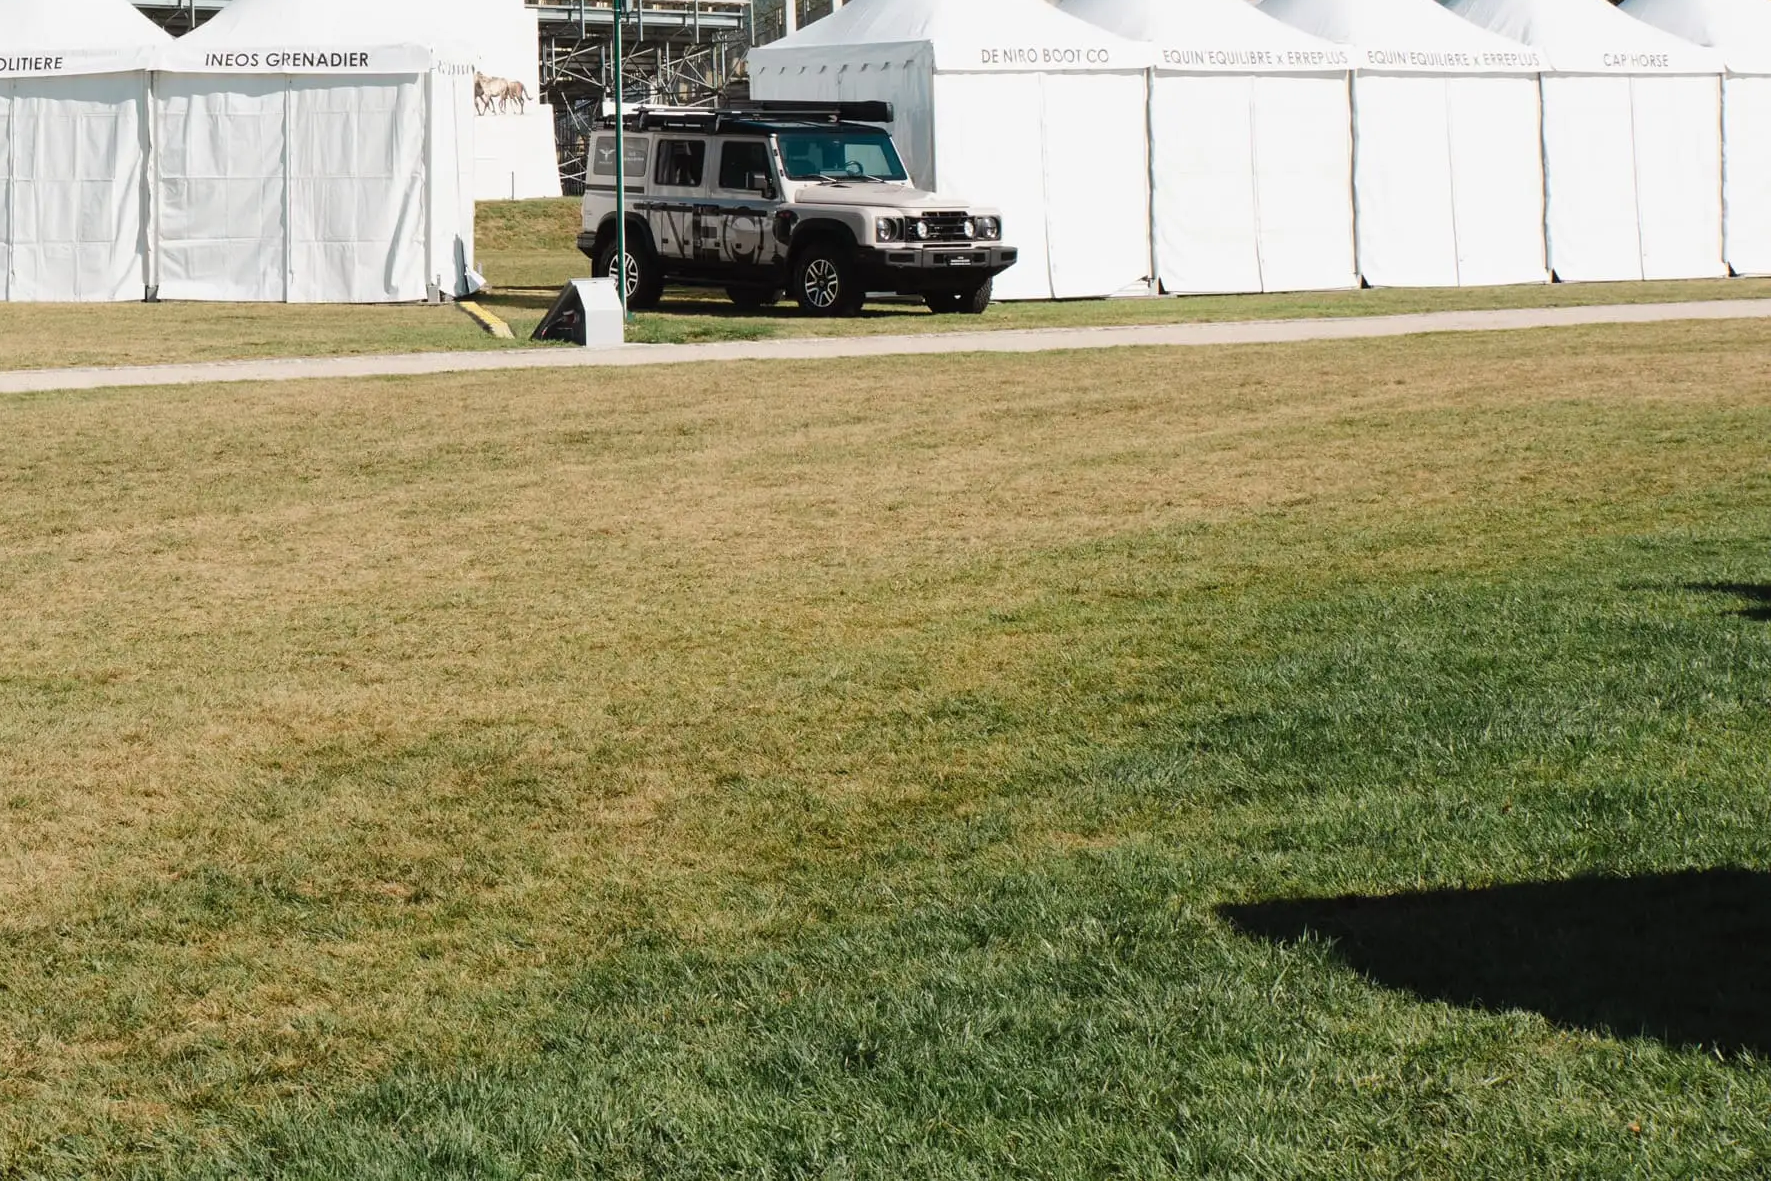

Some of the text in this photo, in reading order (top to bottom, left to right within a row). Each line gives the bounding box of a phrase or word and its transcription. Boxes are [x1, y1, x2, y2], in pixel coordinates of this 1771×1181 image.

[205, 51, 369, 67] INEOS GRENADIER
[982, 49, 1108, 63] DE NIRO BOOT CO
[1288, 50, 1348, 65] ERREPLUS
[1483, 52, 1540, 66] ERREPLUS
